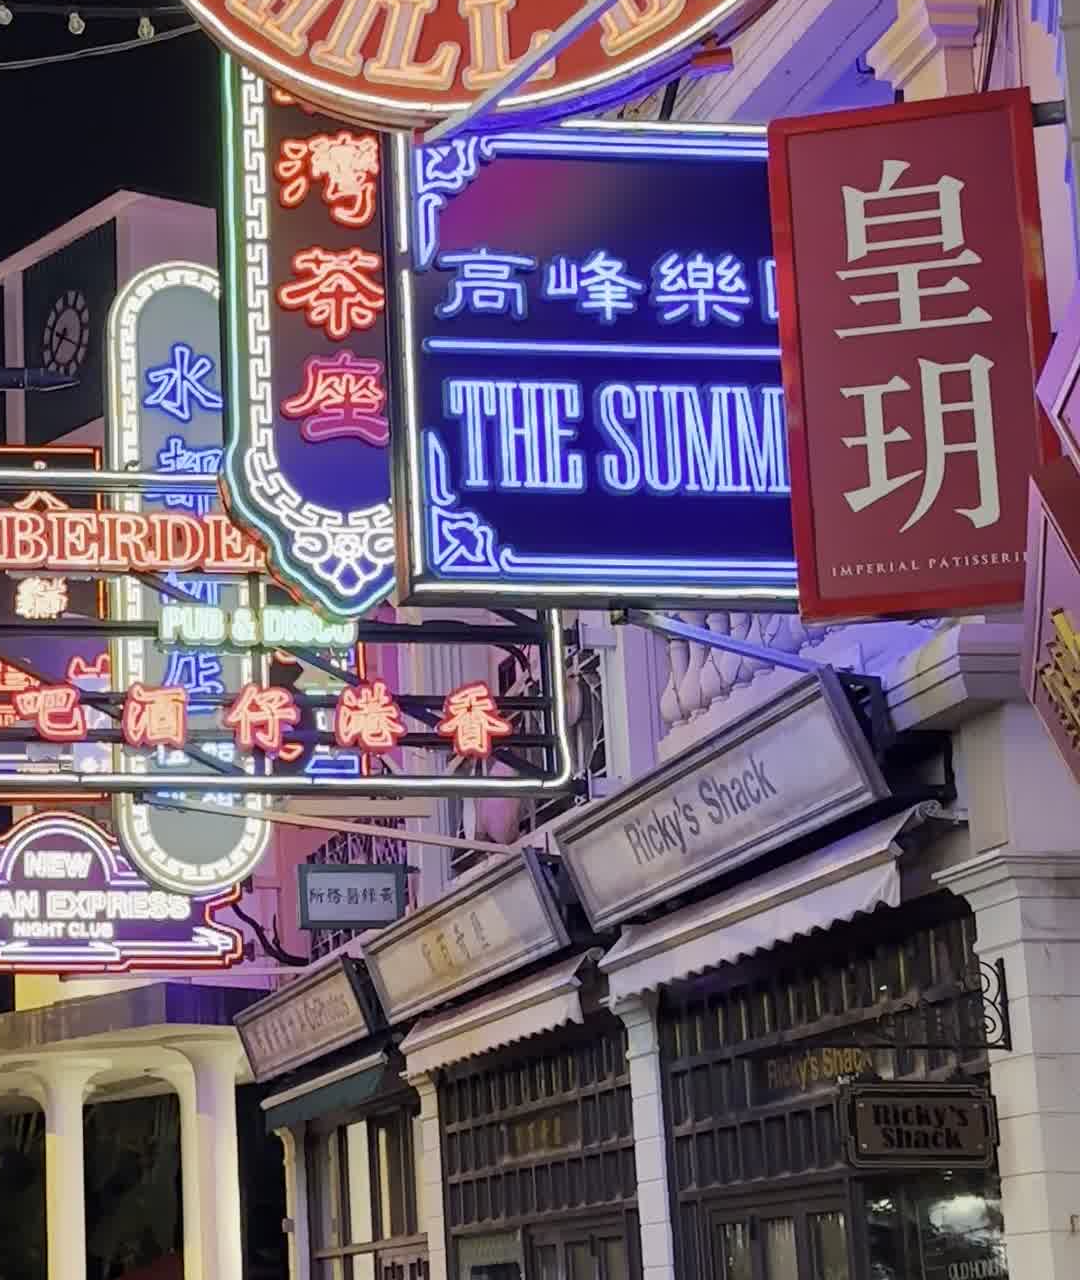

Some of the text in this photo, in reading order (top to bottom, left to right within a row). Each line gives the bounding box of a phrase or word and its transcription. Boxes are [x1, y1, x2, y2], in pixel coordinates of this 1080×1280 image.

[435, 248, 779, 322] 高峰樂
[833, 159, 1001, 534] 皇玥
[445, 378, 584, 491] THE
[832, 559, 920, 578] IMPERIAL
[161, 605, 225, 645] PUB
[231, 606, 258, 644] &
[624, 754, 777, 865] Ricky's Shack
[23, 850, 93, 878] NEW
[46, 889, 191, 919] EXPRESS
[13, 922, 114, 938] NIGHT CLUB
[872, 1103, 969, 1128] Ricky's
[881, 1127, 963, 1149] Shack
